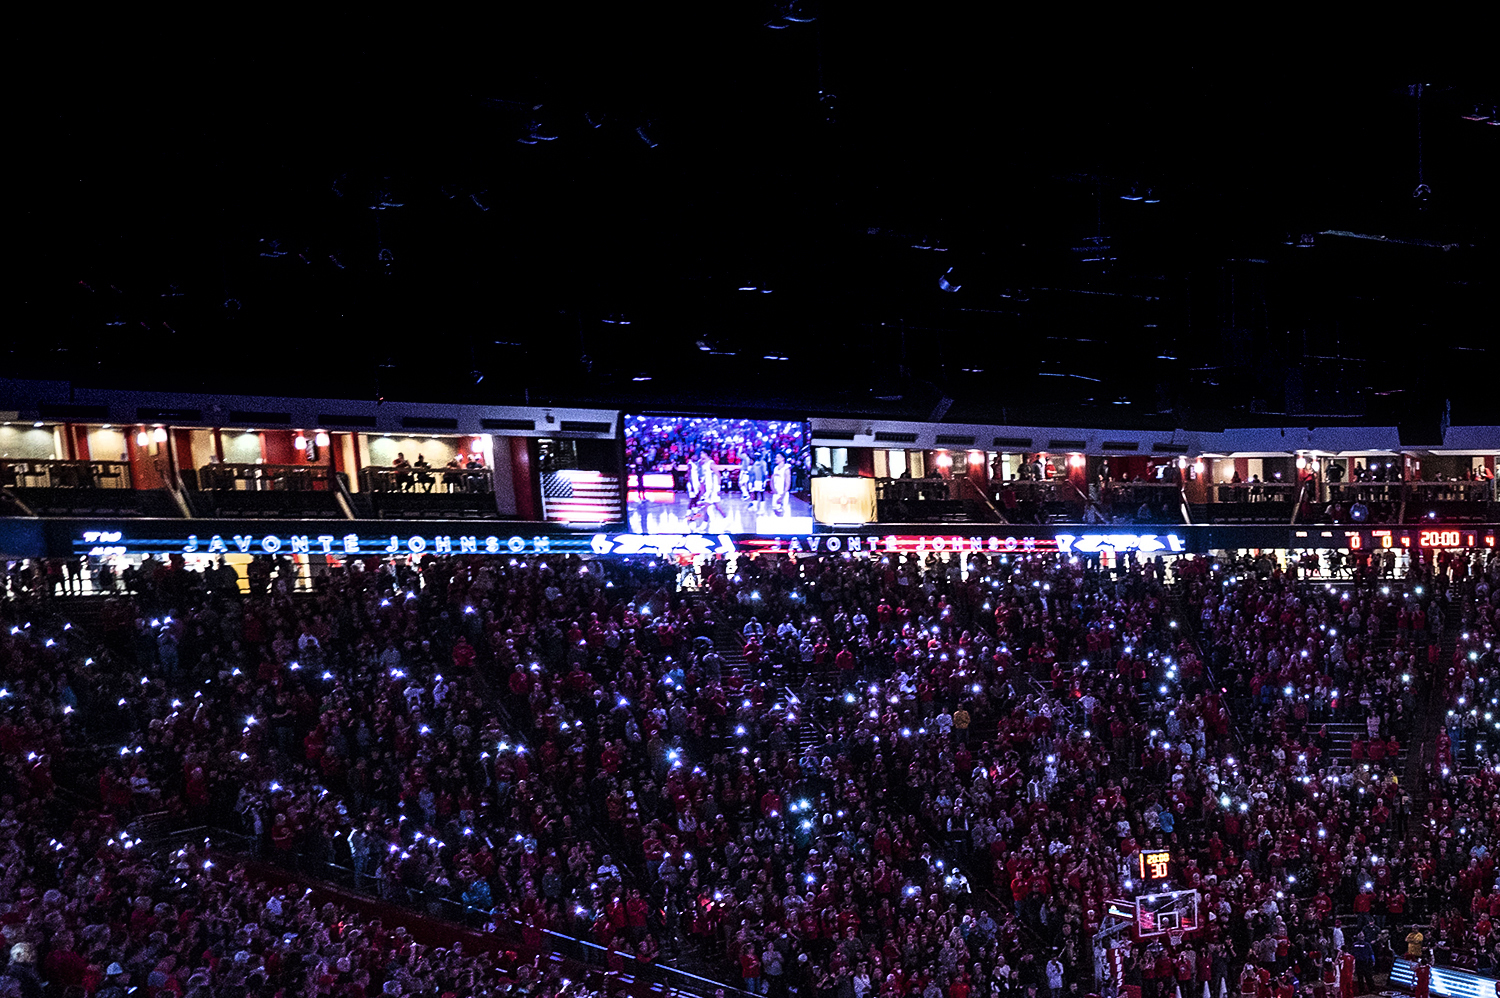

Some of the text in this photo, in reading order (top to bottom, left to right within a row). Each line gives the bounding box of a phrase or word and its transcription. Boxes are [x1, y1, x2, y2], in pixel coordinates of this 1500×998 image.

[386, 536, 550, 553] JOHNSON
[915, 536, 1036, 551] JOHNSON
[1351, 536, 1360, 548] 0
[1382, 535, 1392, 548] 0
[1401, 537, 1410, 547] 4
[1420, 531, 1460, 547] 20:00
[1468, 535, 1474, 546] 1
[1485, 536, 1494, 547] 4
[1151, 862, 1168, 879] 30
